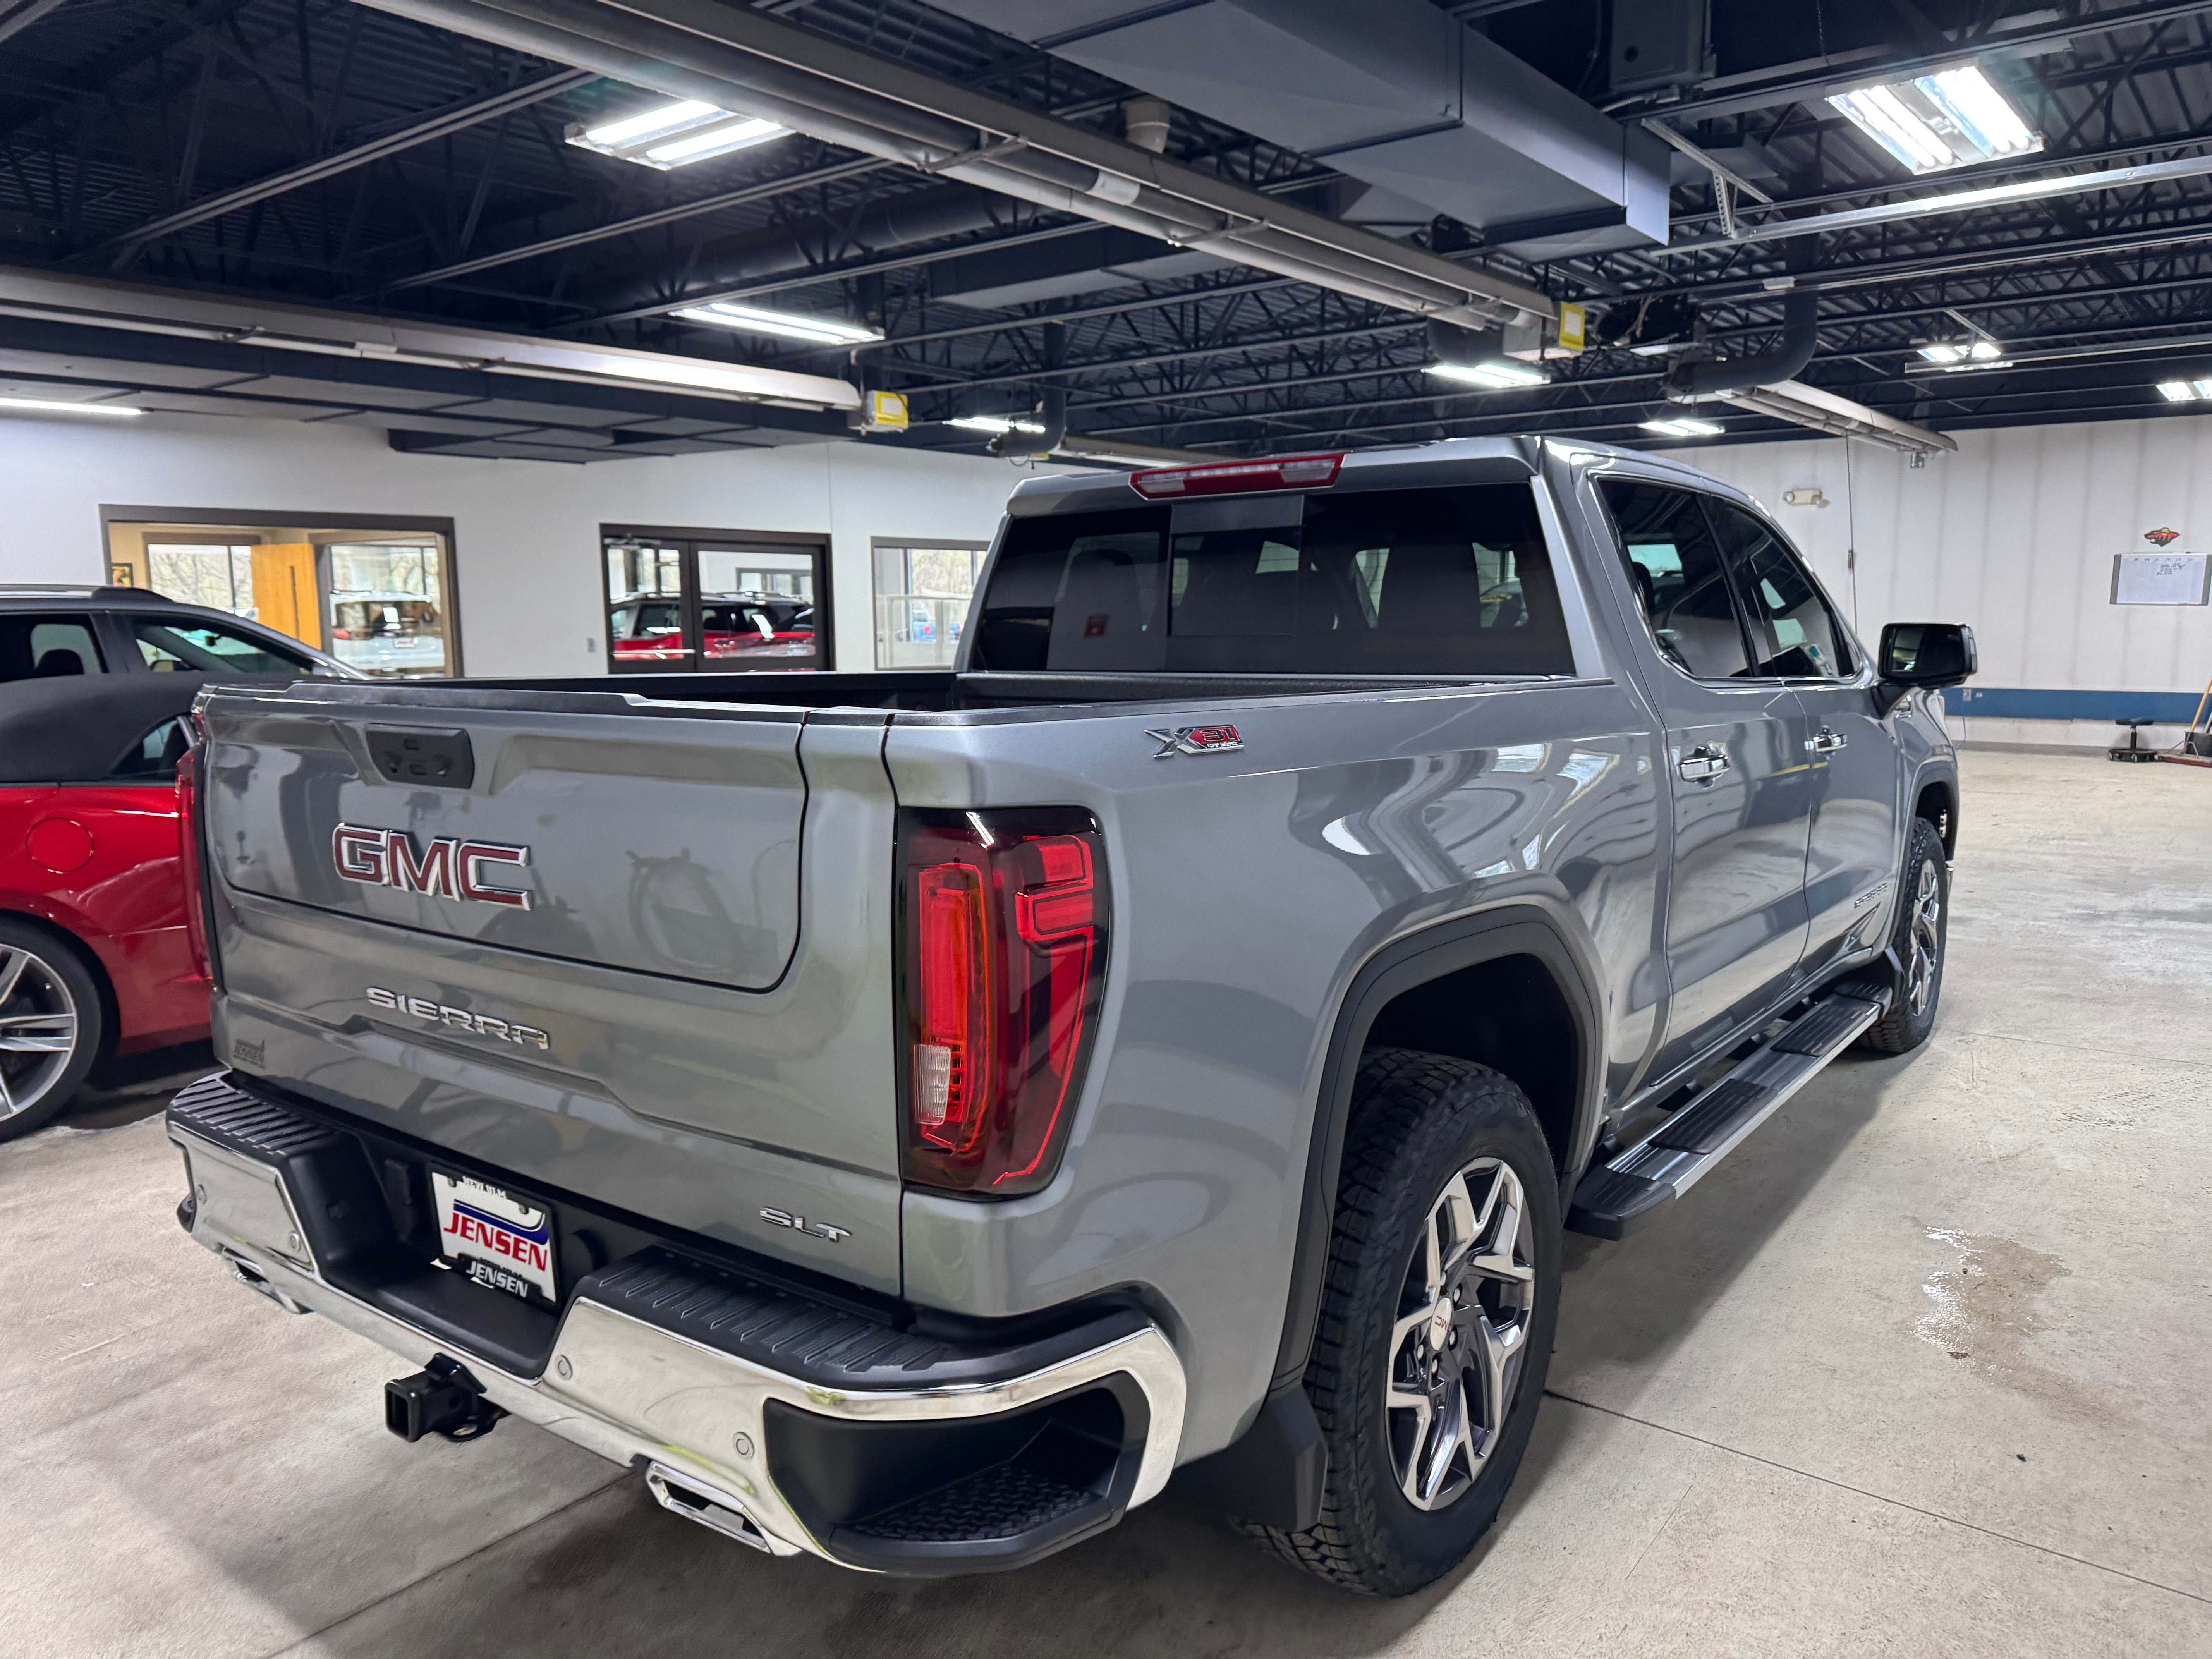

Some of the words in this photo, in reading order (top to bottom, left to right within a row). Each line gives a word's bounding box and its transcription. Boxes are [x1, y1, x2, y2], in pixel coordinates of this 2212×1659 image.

[332, 822, 531, 911] GMC
[366, 986, 549, 1050] SIERRA
[443, 1212, 548, 1272] JENSEN
[759, 1206, 852, 1243] SLT
[465, 1261, 529, 1298] JENSEN
